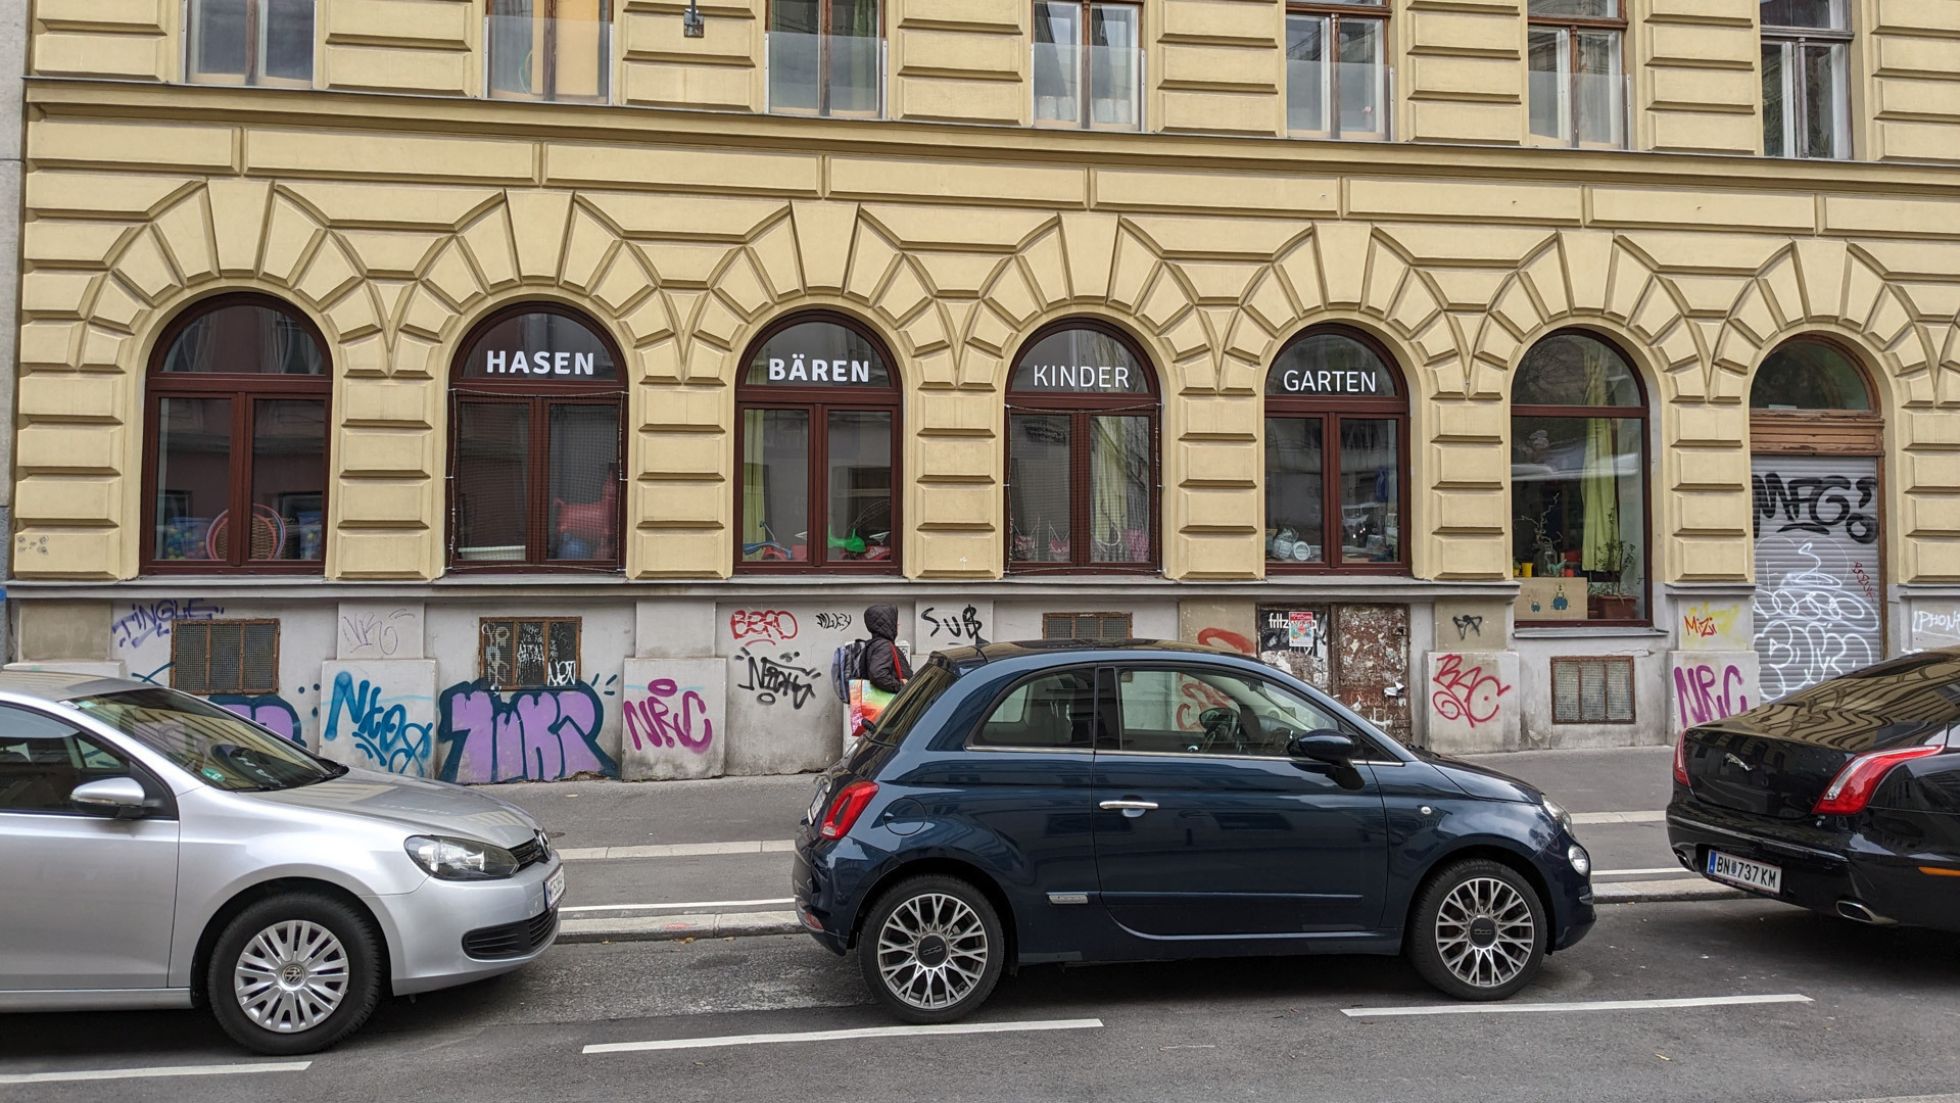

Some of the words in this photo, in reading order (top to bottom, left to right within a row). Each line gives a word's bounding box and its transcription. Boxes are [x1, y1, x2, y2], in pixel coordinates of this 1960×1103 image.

[487, 350, 595, 376] HASEN
[768, 353, 871, 383] BÄREN
[1033, 365, 1130, 389] KINDER
[1283, 369, 1377, 393] GARTEN
[1717, 856, 1730, 875] BN
